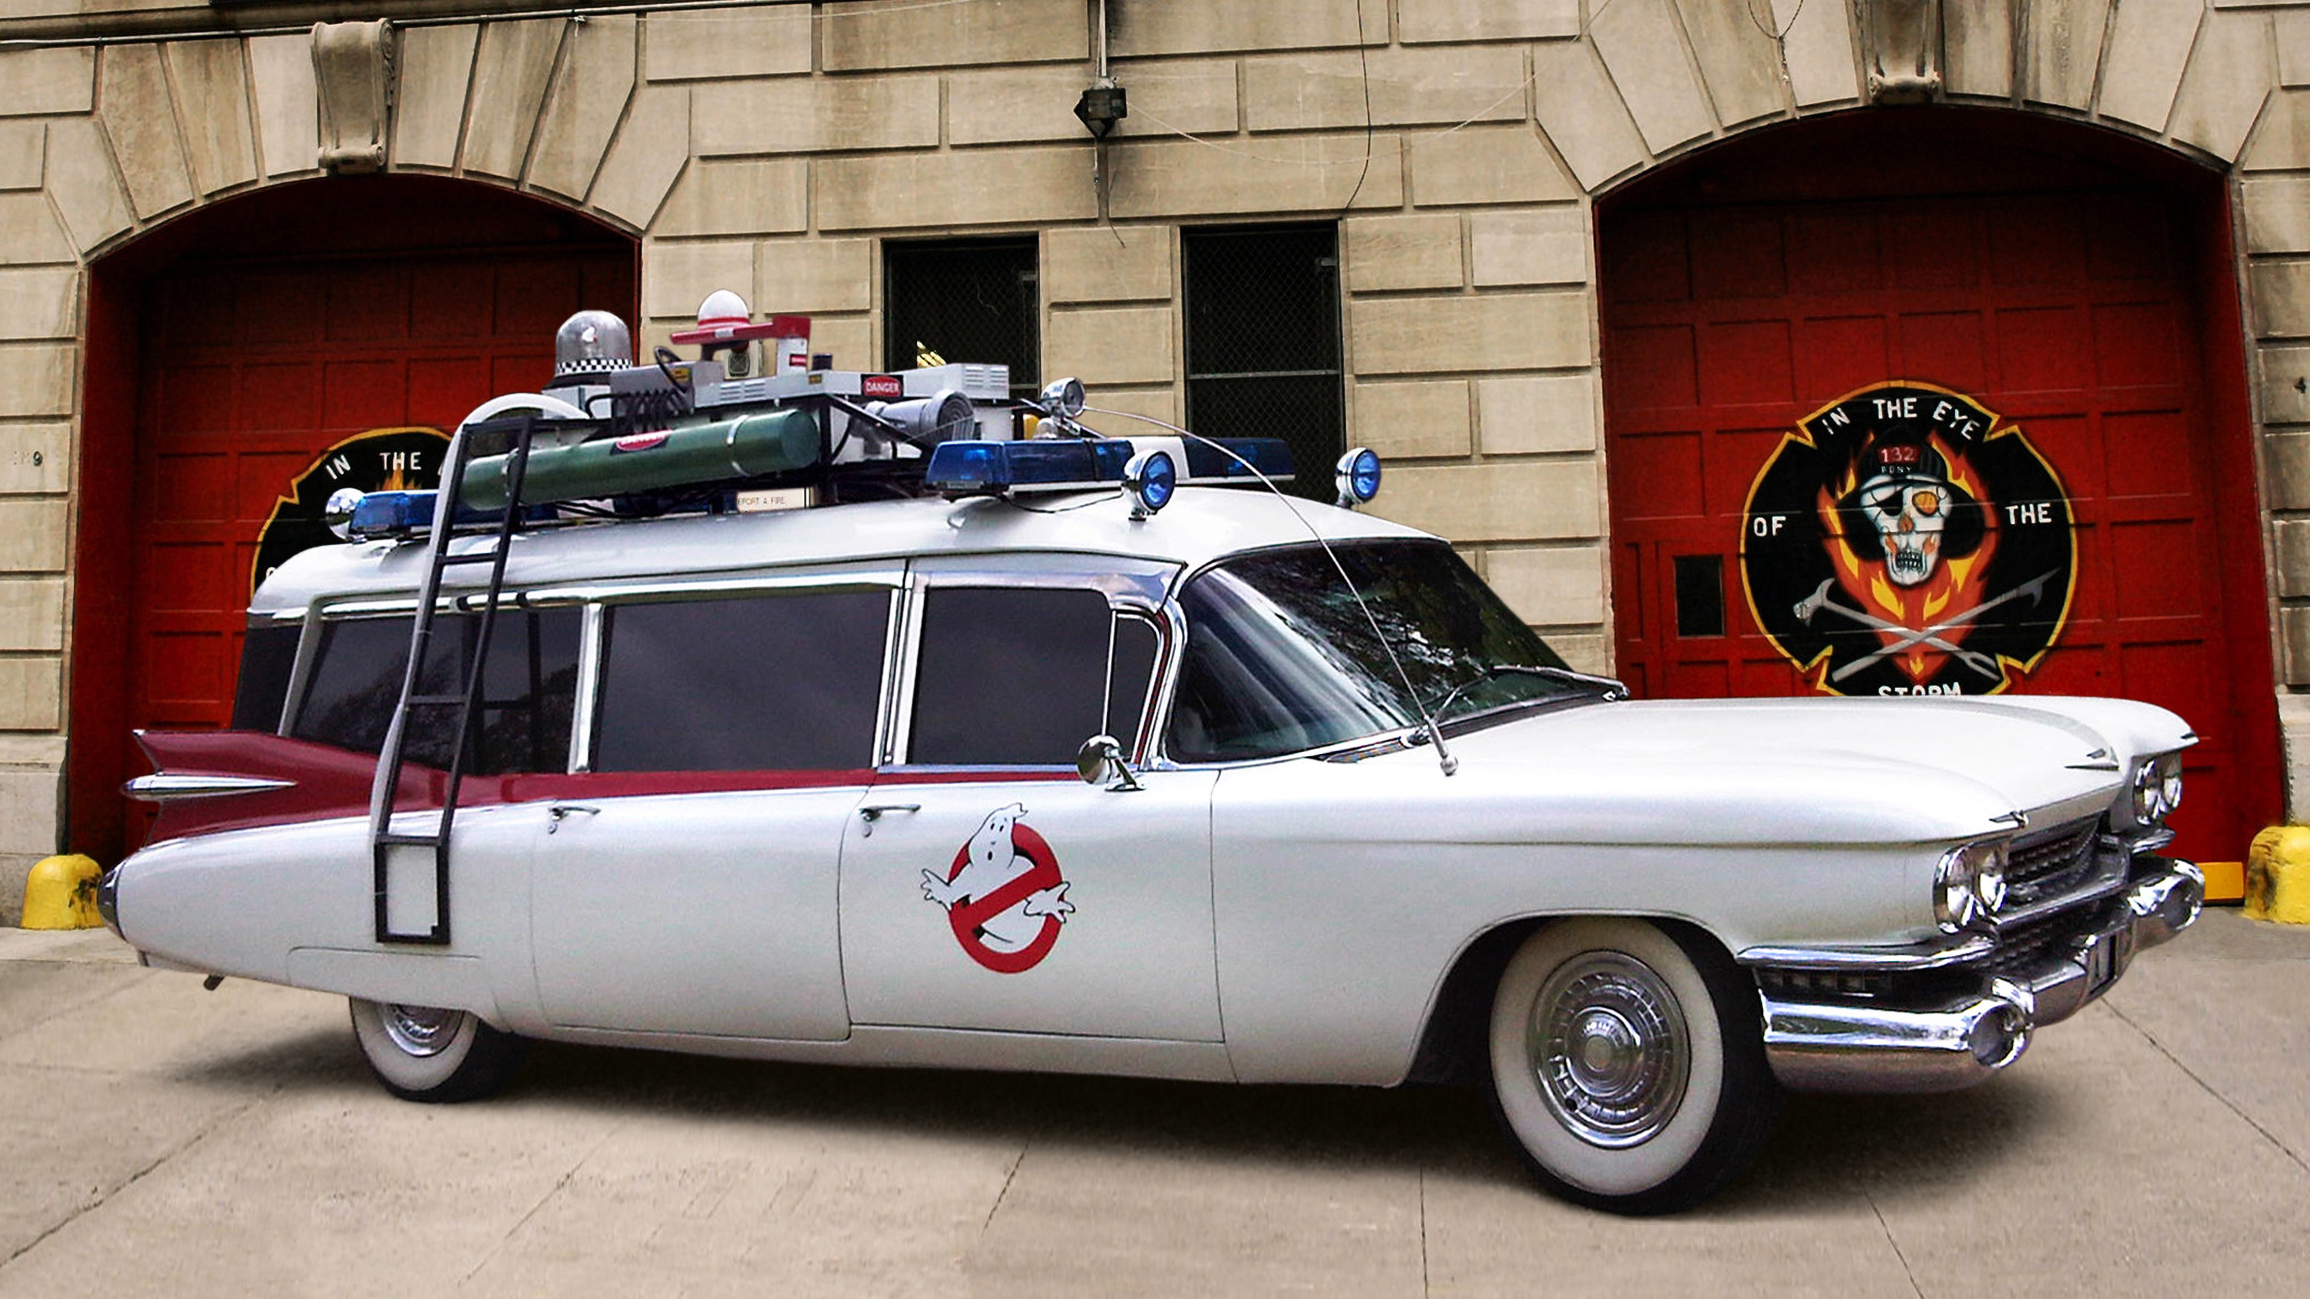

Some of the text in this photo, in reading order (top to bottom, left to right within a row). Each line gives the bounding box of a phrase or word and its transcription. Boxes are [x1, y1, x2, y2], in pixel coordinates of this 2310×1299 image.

[865, 382, 900, 394] DANGER
[1821, 397, 1981, 441] IN THE EYE
[325, 454, 351, 480] IN
[379, 451, 422, 471] THE
[1881, 446, 1915, 463] 132
[1752, 502, 2053, 538] OF THE
